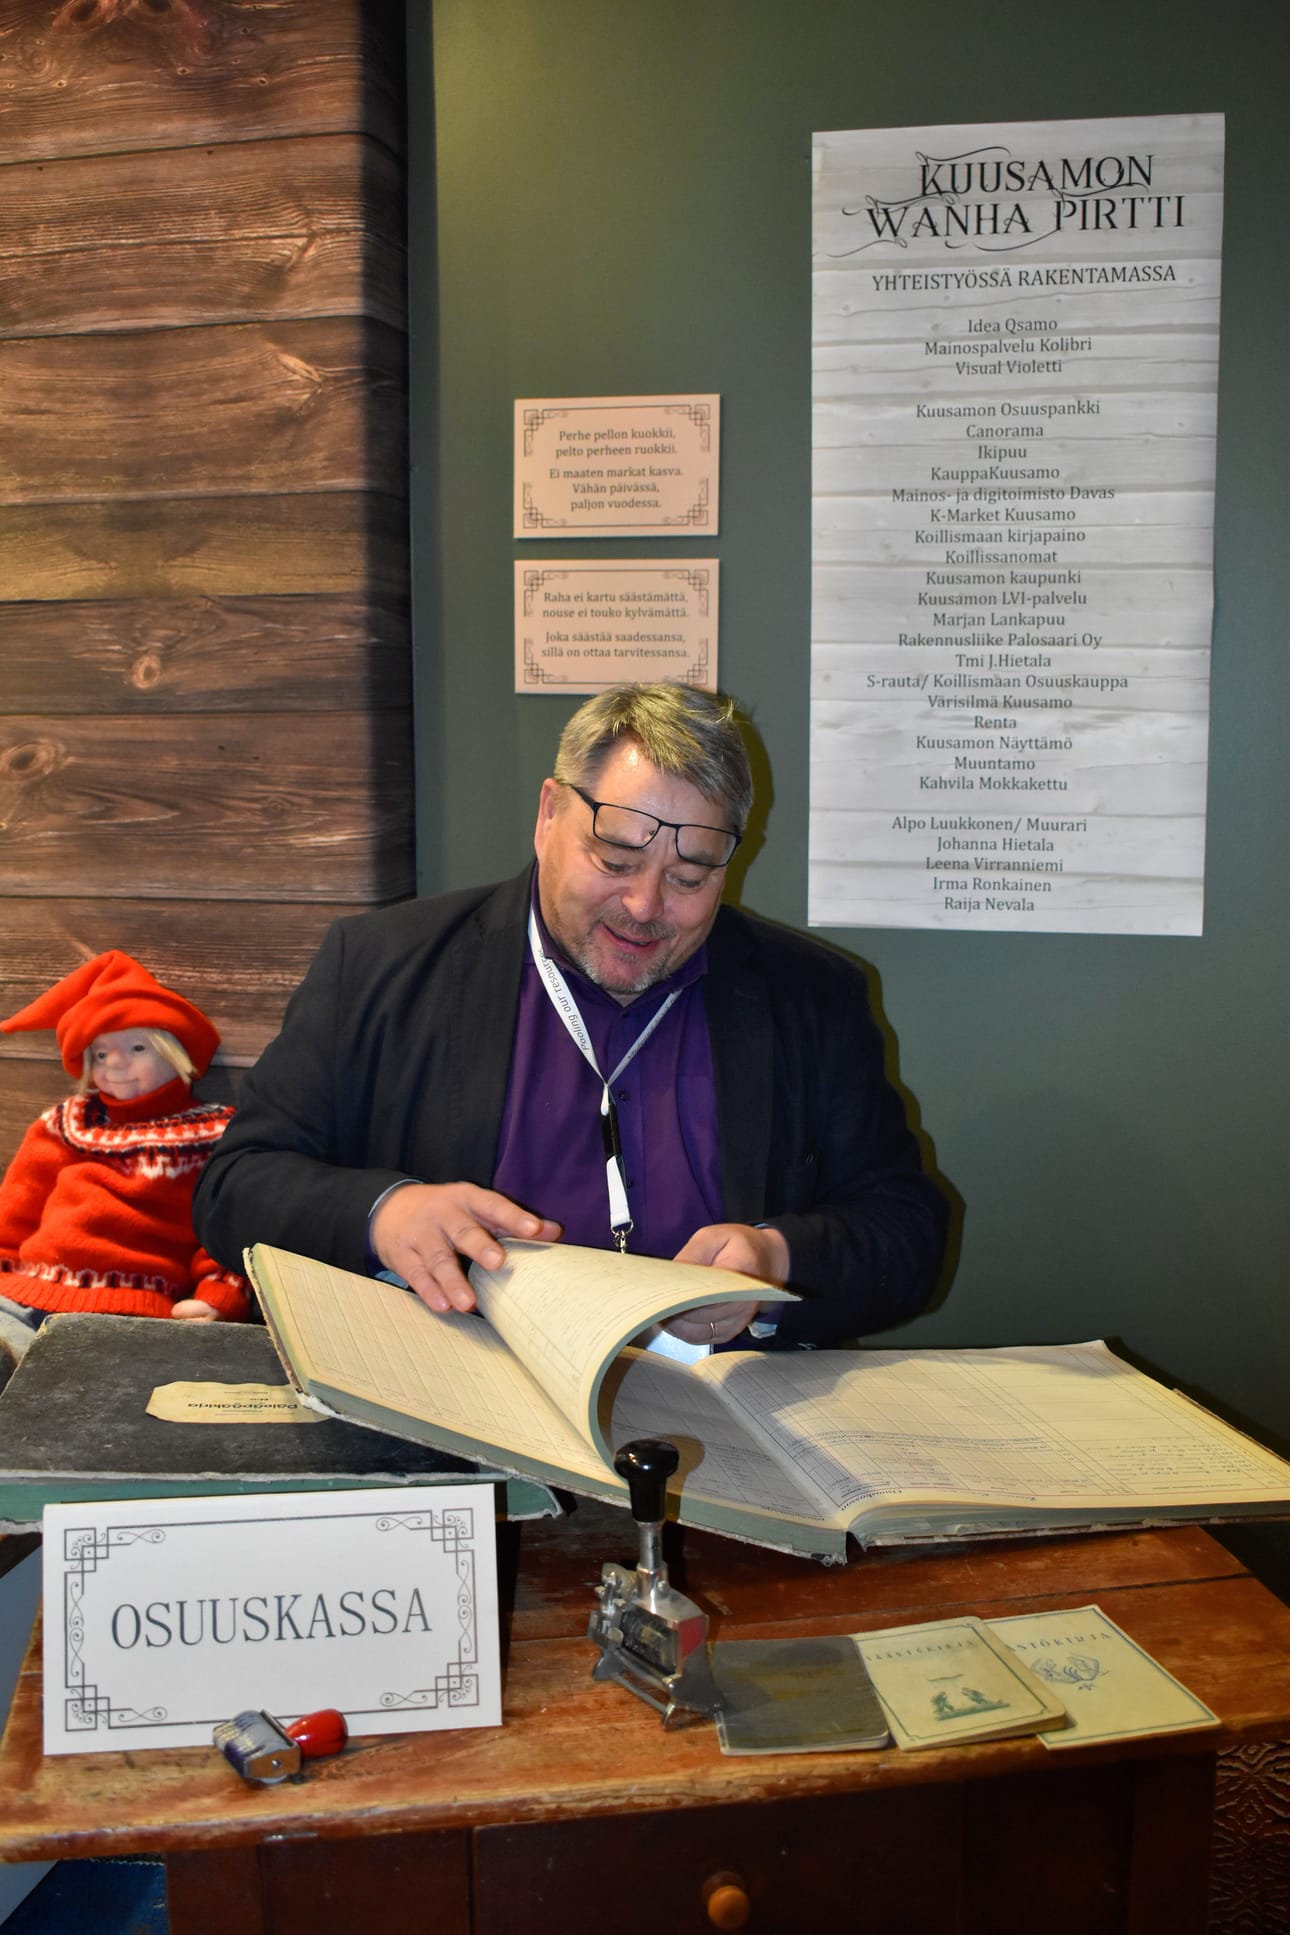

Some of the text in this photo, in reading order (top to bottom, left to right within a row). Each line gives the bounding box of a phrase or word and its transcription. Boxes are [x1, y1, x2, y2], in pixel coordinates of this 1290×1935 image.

[915, 147, 1154, 198] KUUSAMON
[1054, 190, 1185, 232] PIRTTI
[872, 265, 1177, 292] YHTEISTYÖSSÄ RAKENTAMASSA
[968, 318, 1058, 336] Idea Qsamo
[924, 338, 1092, 357] Mainospalvelu Kolibri
[955, 360, 1062, 376] Visual Violetti
[916, 401, 1100, 420] Kuusamon Osuuspankki
[559, 427, 676, 443] Perhe pellon kuokkii,
[966, 425, 1044, 438] Canorama
[556, 443, 678, 459] pelto perheen ruokkii.
[978, 446, 1028, 464] Ikipuu
[549, 466, 683, 479] Ei maaten markat kasva.
[930, 467, 1060, 485] KauppaKuusamo
[572, 482, 660, 496] Vähän päivässä,
[892, 487, 1115, 505] Mainos- ja digitoimisto Davas
[571, 498, 661, 512] paljon vuodessa.
[930, 508, 1076, 523] K-Market Kuusamo
[914, 529, 1086, 547] Koillismaan kirjapaino
[945, 550, 1058, 565] Koillissanomat
[926, 571, 1081, 589] Kuusamon kaupunki
[544, 591, 687, 604] Raha ei kartu säästämättä,
[918, 591, 1087, 609] Kuusamon LVI-palvelu
[543, 607, 689, 620] nouse ei touko kylvämättä.
[933, 613, 1066, 629] Marjan Lankapuu
[545, 632, 686, 644] Joka säästää saadessansa,
[899, 633, 1103, 650] Rakennusliike Palosaari Oy
[542, 647, 689, 658] sillä on ottaa tarvitessansa.
[955, 654, 1051, 670] Tmi J.Hietala
[867, 674, 1128, 692] S-rauta/ Koillismaan Osuuskauppa
[928, 695, 1073, 709] Värisilmä Kuusamo
[974, 716, 1017, 729] Renta
[916, 736, 1073, 753] Kuusamon Näyttämö
[954, 757, 1036, 770] Muuntamo
[919, 777, 1068, 791] Kahvila Mokkakettu
[892, 817, 1088, 834] Alpo Luukkonen/ Muurari
[937, 837, 1055, 853] Johanna Hietala
[925, 857, 1064, 873] Leena Virranniemi
[933, 877, 1052, 893] Irma Ronkainen
[944, 897, 1035, 913] Raija Nevala
[558, 994, 572, 1013] our
[568, 1013, 590, 1051] Pooling
[111, 1586, 434, 1650] OSUUSKASSA
